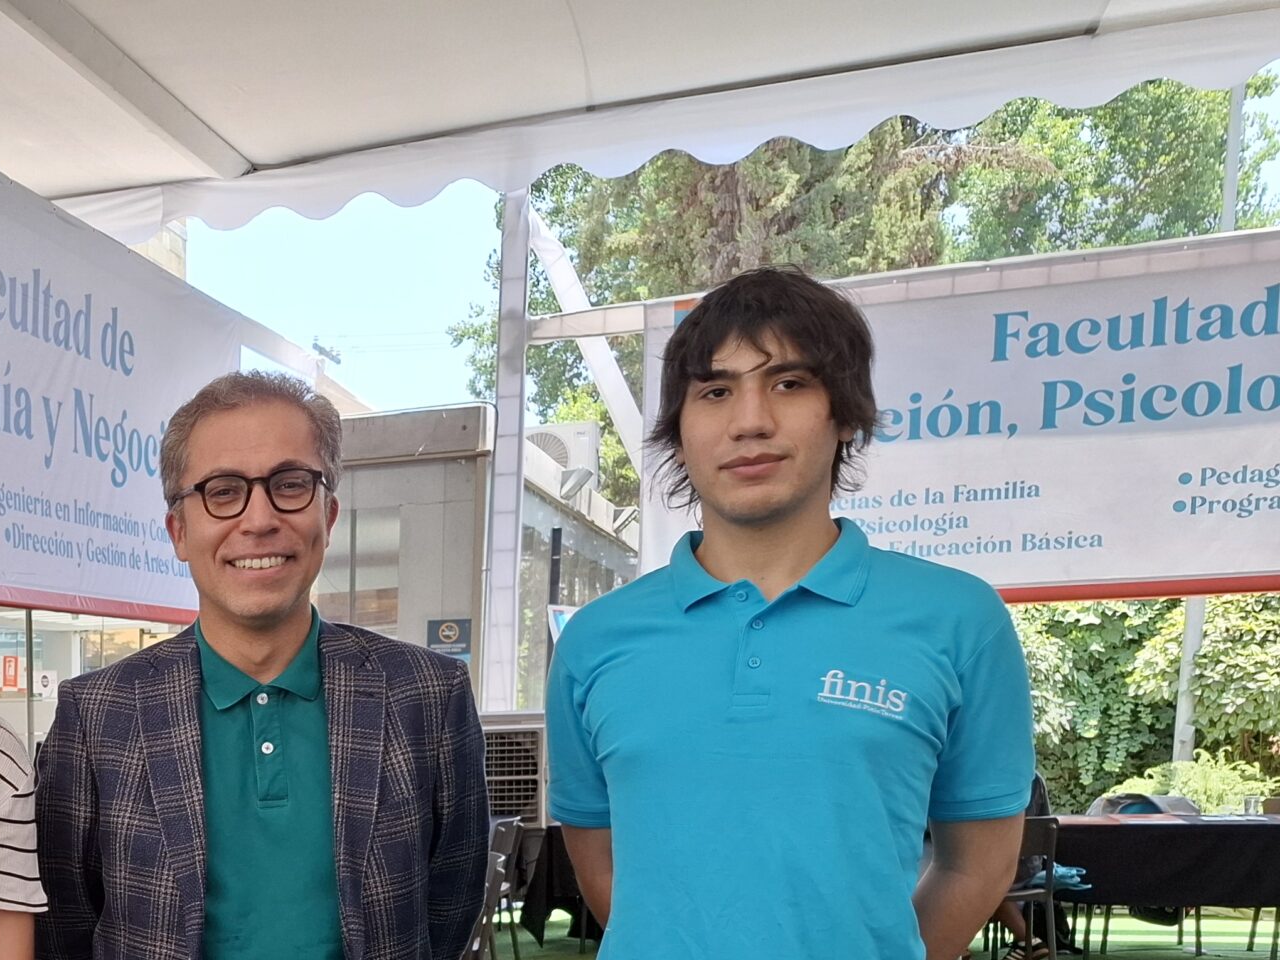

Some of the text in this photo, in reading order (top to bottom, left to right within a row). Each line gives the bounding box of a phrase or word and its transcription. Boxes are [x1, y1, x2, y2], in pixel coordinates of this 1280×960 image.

[101, 306, 135, 377] de
[991, 283, 1280, 362] Facultad
[1039, 363, 1280, 431] Psicolo
[42, 394, 63, 470] y
[890, 489, 917, 508] de
[924, 487, 945, 505] la
[953, 480, 1041, 503] Familia
[55, 500, 70, 522] en
[73, 499, 140, 538] Información
[141, 522, 147, 546] y
[1021, 532, 1104, 552] Básica
[12, 523, 73, 558] Dirección
[77, 542, 84, 568] y
[86, 538, 126, 568] Gestión
[129, 547, 141, 570] de
[144, 549, 169, 575] Artes
[820, 669, 908, 712] finis
